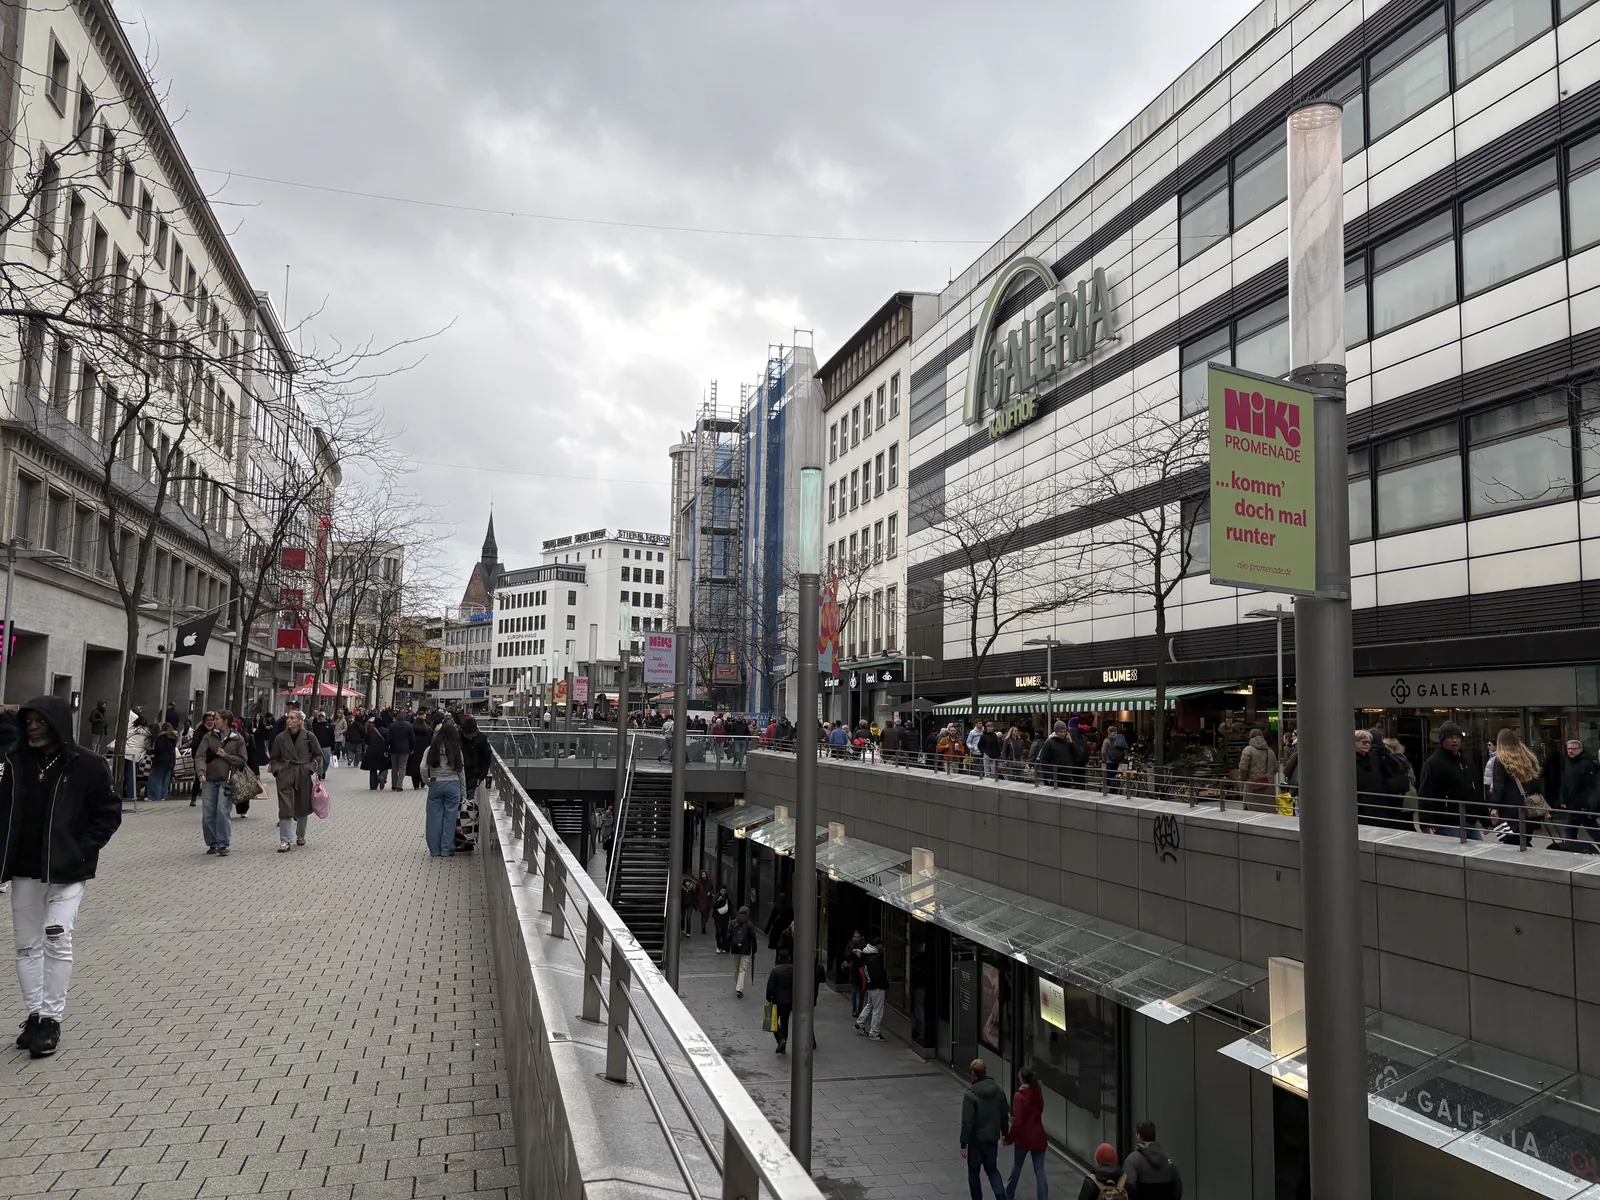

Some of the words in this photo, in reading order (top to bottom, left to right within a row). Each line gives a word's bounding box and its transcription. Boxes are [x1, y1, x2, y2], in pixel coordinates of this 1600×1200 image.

[985, 266, 1113, 410] GALERIA
[1225, 434, 1301, 463] PROMENADE
[1234, 498, 1274, 522] doch
[1278, 509, 1308, 528] mal
[1226, 525, 1276, 547] runter
[1015, 676, 1037, 688] BLUME
[1102, 669, 1131, 683] BLUME
[1417, 682, 1491, 697] GALERIA
